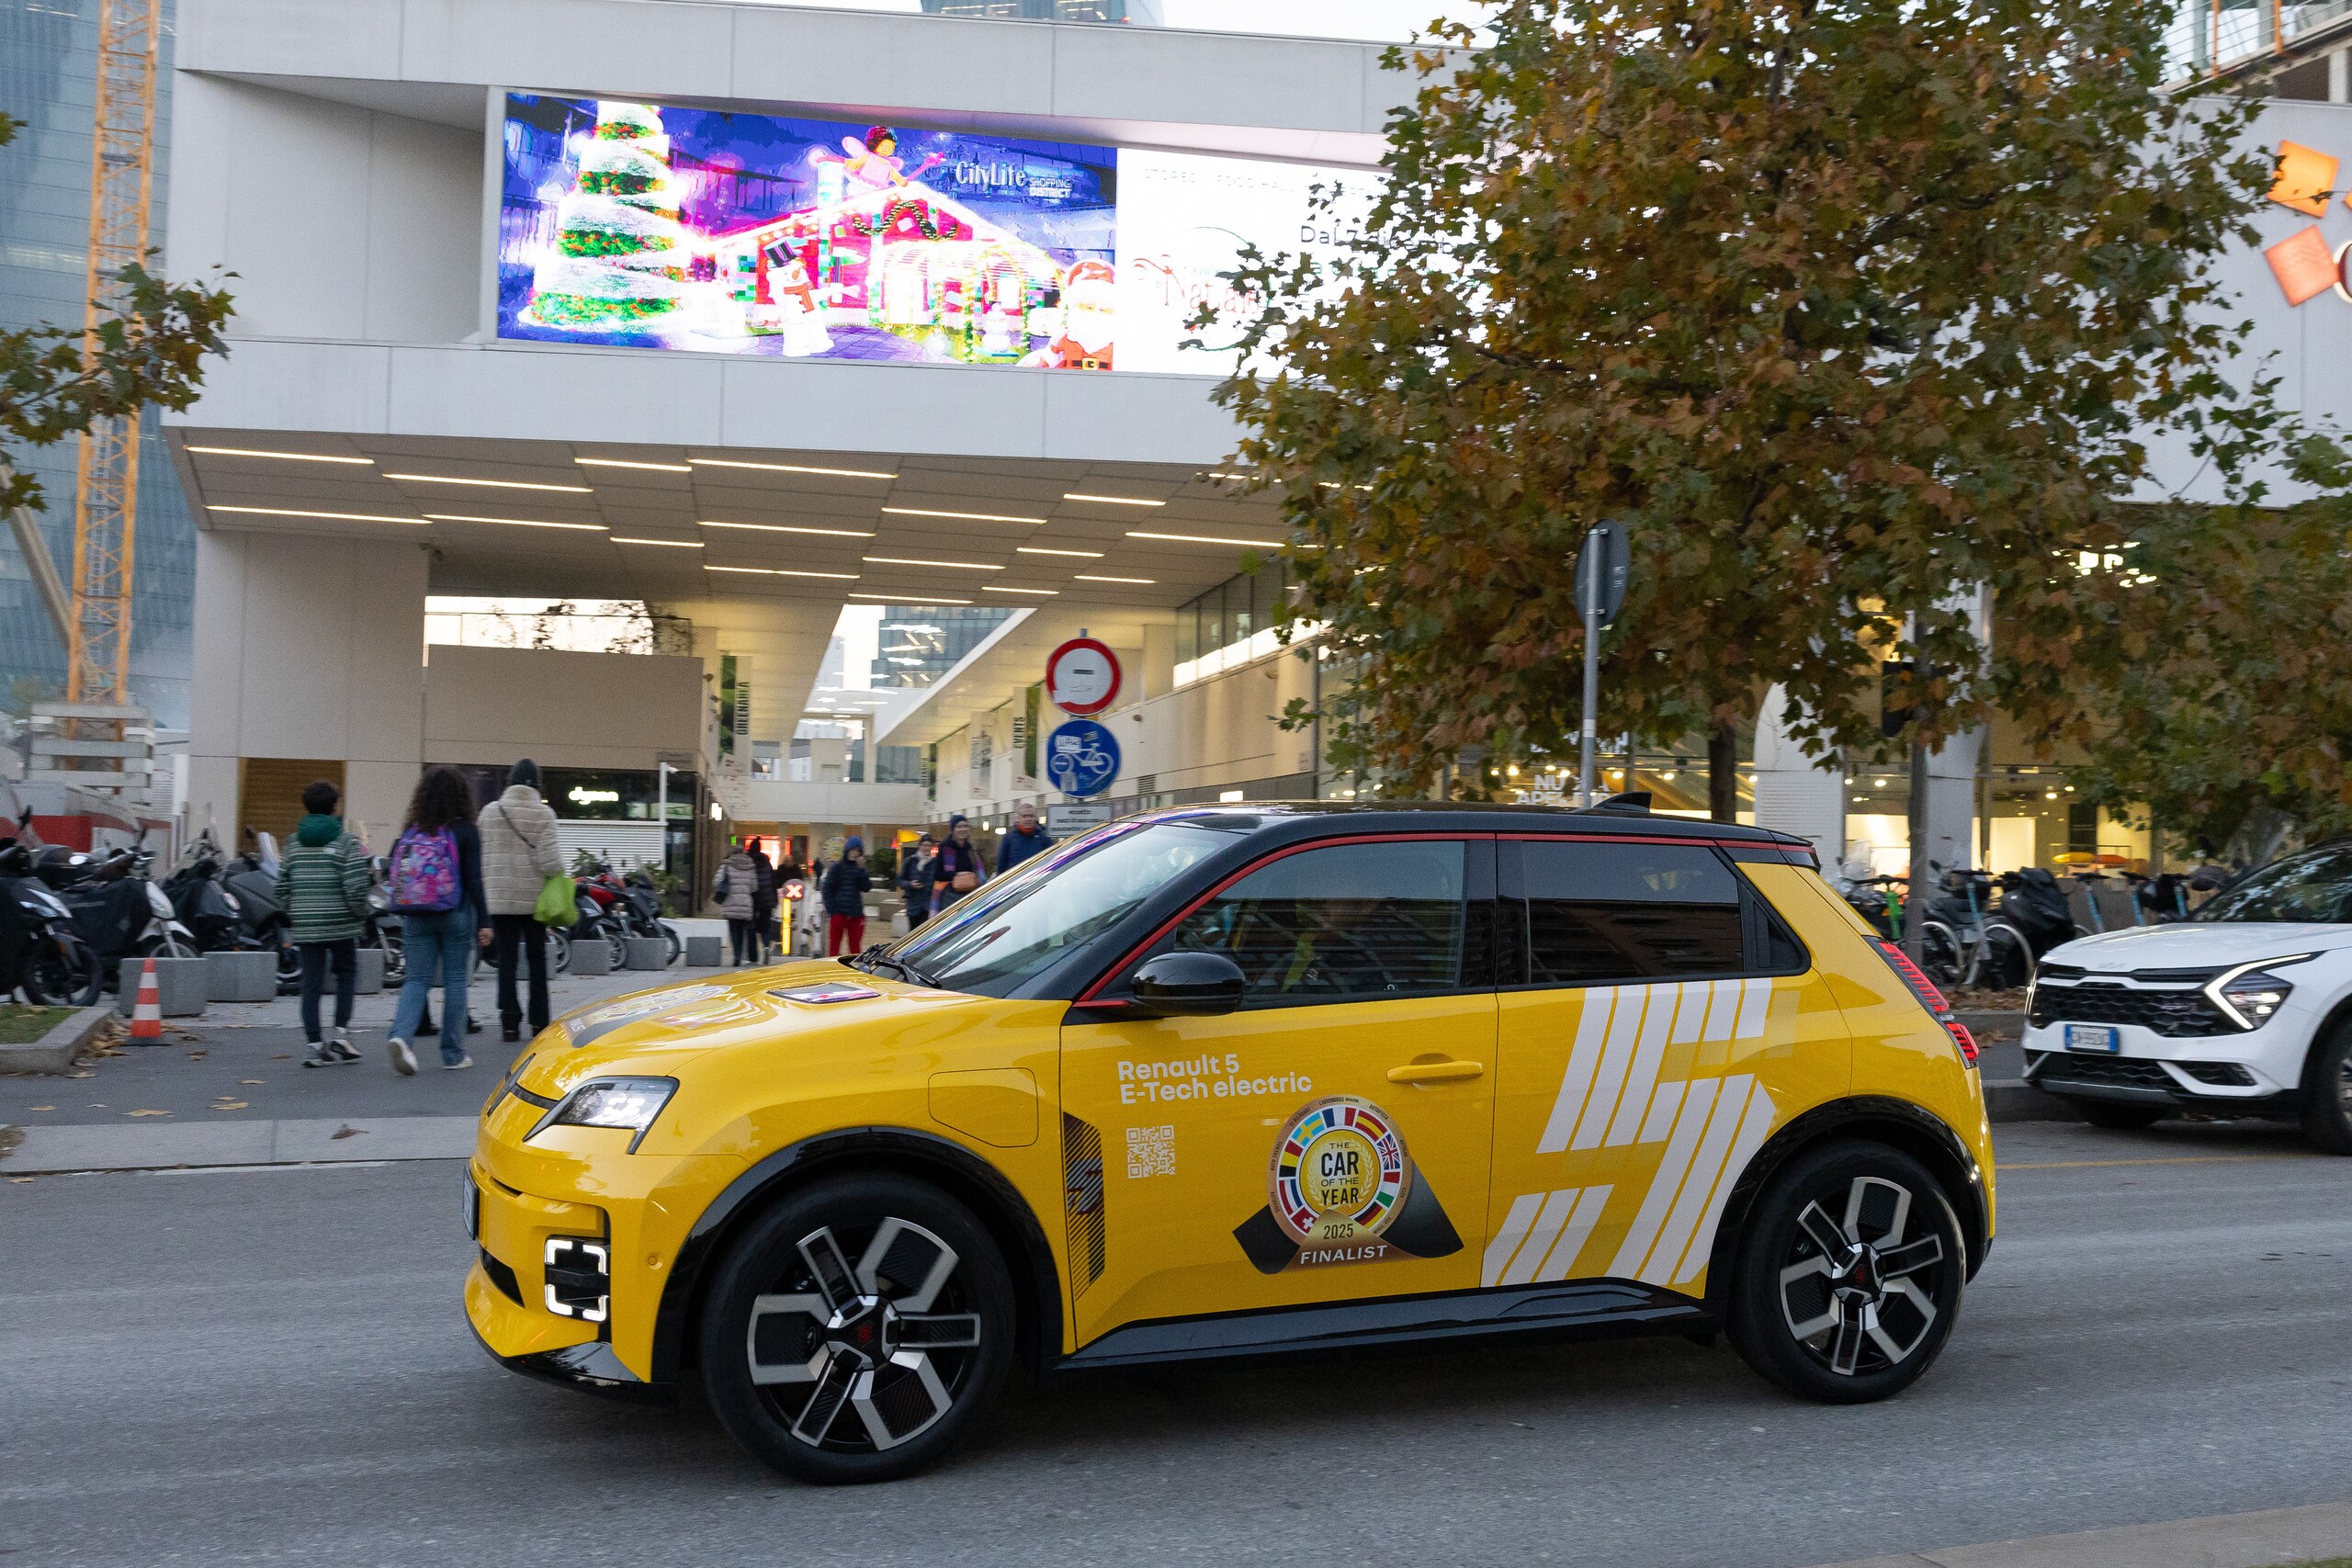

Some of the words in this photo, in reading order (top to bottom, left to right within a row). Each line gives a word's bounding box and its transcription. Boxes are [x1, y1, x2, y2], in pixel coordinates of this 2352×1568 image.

[956, 161, 1027, 193] CityLife
[1029, 176, 1072, 188] SHOPPING
[1029, 186, 1072, 198] DISTRICT
[1300, 225, 1339, 246] Dal
[1013, 716, 1026, 750] EVENTS
[1117, 1055, 1220, 1081] Renault
[1226, 1054, 1240, 1074] 5
[1119, 1078, 1210, 1104] E-Tech
[1213, 1072, 1312, 1098] electric
[1369, 1104, 1388, 1121] AUTOPISTA
[1329, 1142, 1351, 1150] THE
[1320, 1151, 1360, 1178] CAR
[1320, 1179, 1336, 1187] OF
[1338, 1177, 1360, 1186] THE
[1320, 1187, 1360, 1207] YEAR
[1323, 1223, 1354, 1240] 2025
[1300, 1245, 1387, 1265] FINALIST
